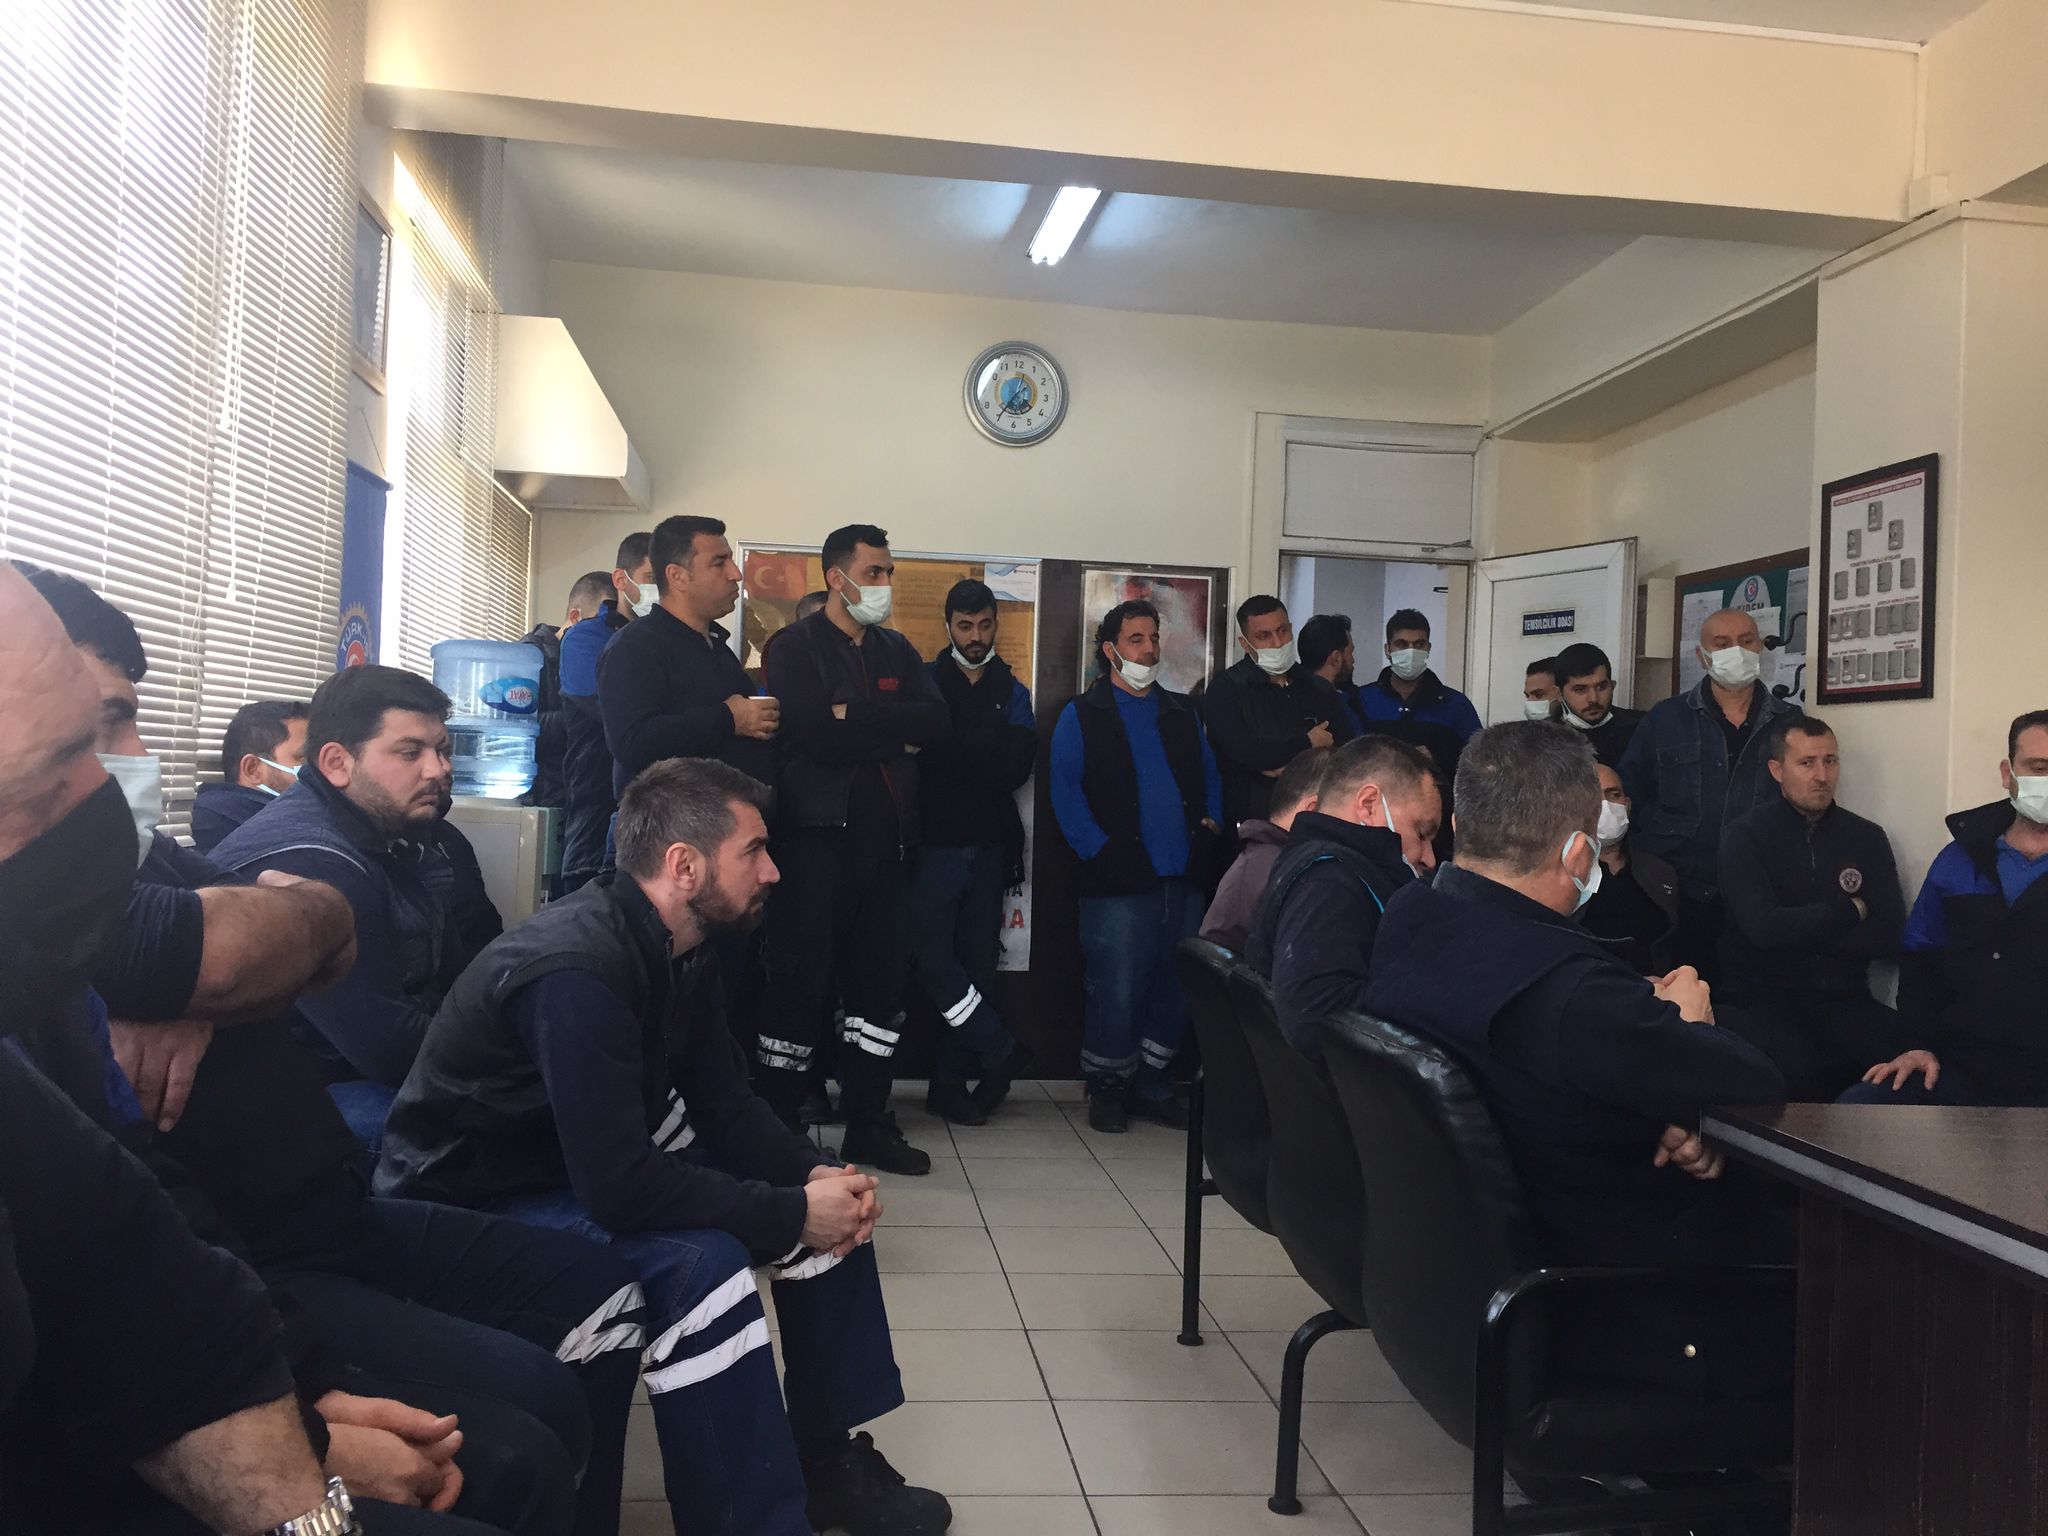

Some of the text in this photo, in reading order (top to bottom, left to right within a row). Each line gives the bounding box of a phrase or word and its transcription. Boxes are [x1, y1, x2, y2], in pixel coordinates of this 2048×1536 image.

[1000, 363, 1008, 371] 11
[1015, 361, 1024, 369] 12
[1041, 378, 1046, 386] 2
[1011, 420, 1016, 429] 6
[1026, 418, 1032, 426] 5
